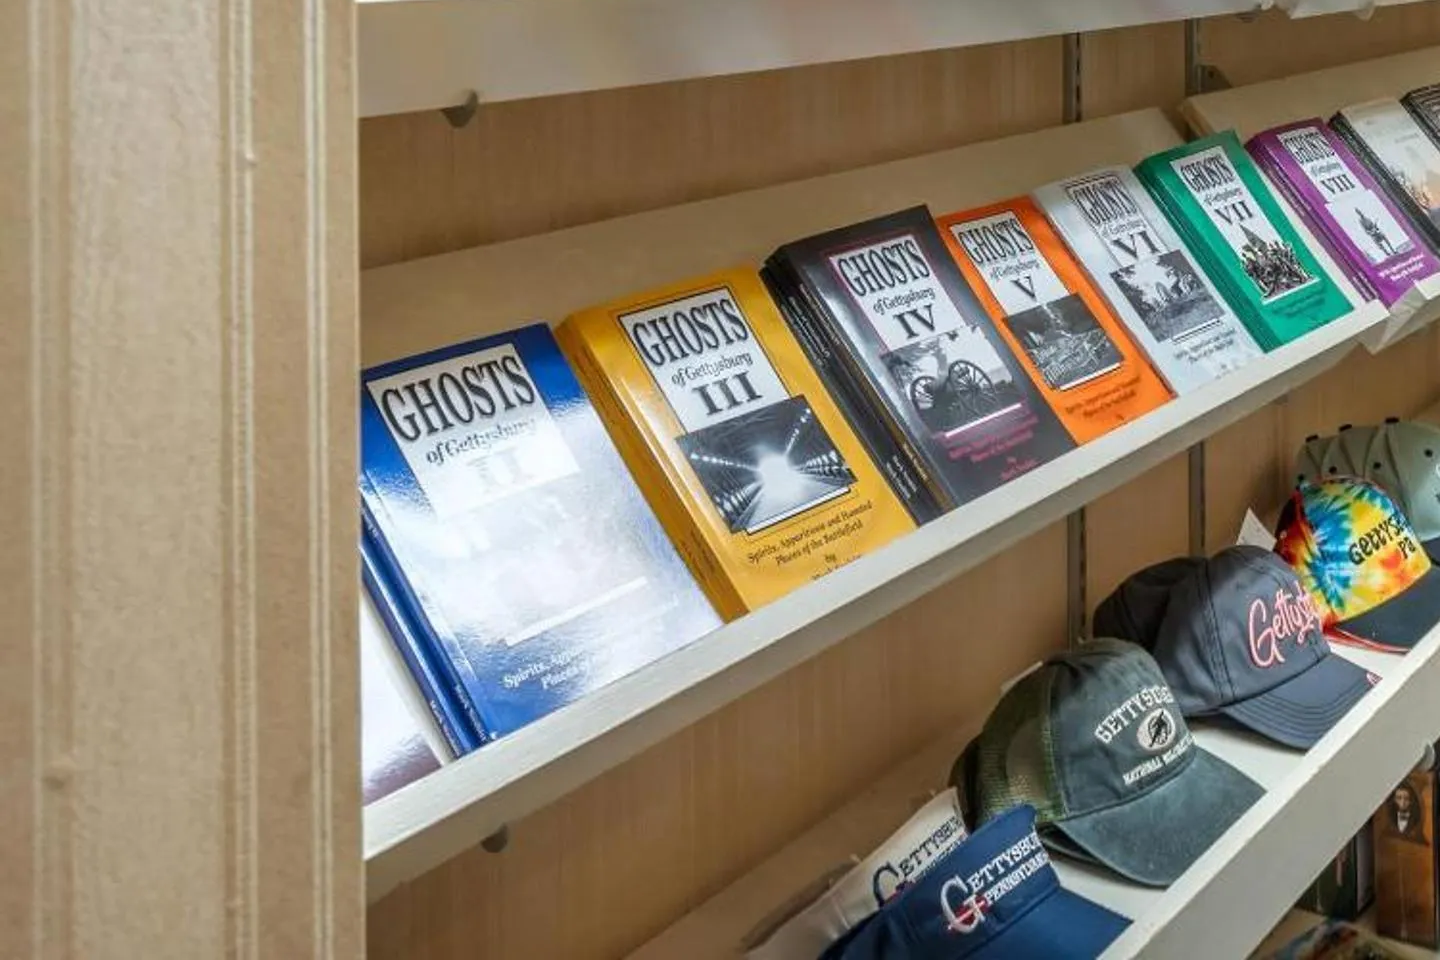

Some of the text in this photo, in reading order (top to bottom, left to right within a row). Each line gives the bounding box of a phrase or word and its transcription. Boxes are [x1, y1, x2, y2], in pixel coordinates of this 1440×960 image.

[1181, 155, 1235, 192] GHOSTS
[1321, 174, 1356, 194] VIII
[1074, 178, 1137, 226] GHOSTS
[1214, 200, 1253, 225] VII
[958, 218, 1035, 265] GHOSTS
[1111, 230, 1161, 260] VI
[838, 239, 930, 297] GHOSTS
[1009, 275, 1038, 302] V
[633, 298, 750, 367] GHOSTS
[892, 304, 935, 339] IV
[671, 351, 754, 387] of Gettysburg
[381, 353, 537, 442] GHOSTS
[691, 371, 764, 416] III
[426, 438, 447, 465] of
